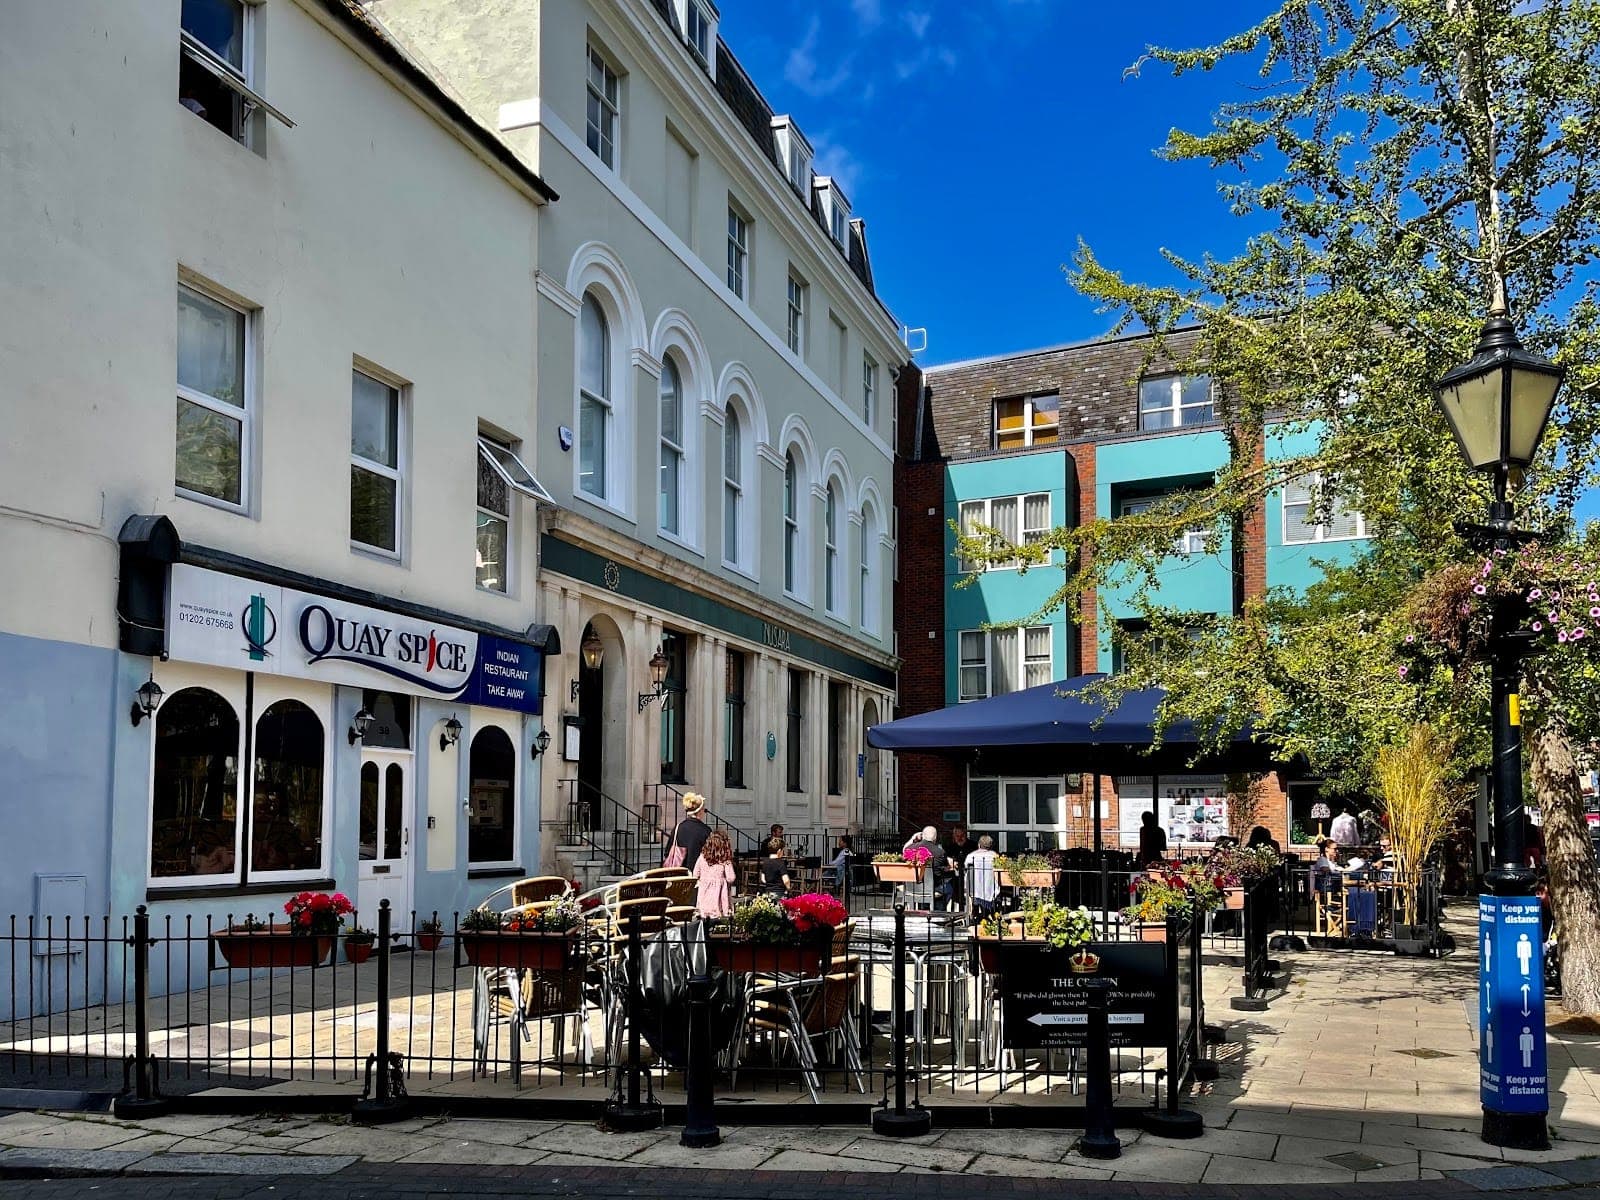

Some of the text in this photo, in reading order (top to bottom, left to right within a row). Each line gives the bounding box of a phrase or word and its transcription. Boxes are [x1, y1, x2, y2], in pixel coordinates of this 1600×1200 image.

[179, 612, 205, 626] 01202
[299, 604, 467, 673] QUAY SPICE
[496, 650, 519, 664] INDIAN
[484, 663, 529, 681] RESTAURANT
[487, 684, 525, 700] TAKE AWAY
[1501, 904, 1523, 914] Keep
[1050, 978, 1074, 987] THE
[1506, 1076, 1528, 1086] Keep
